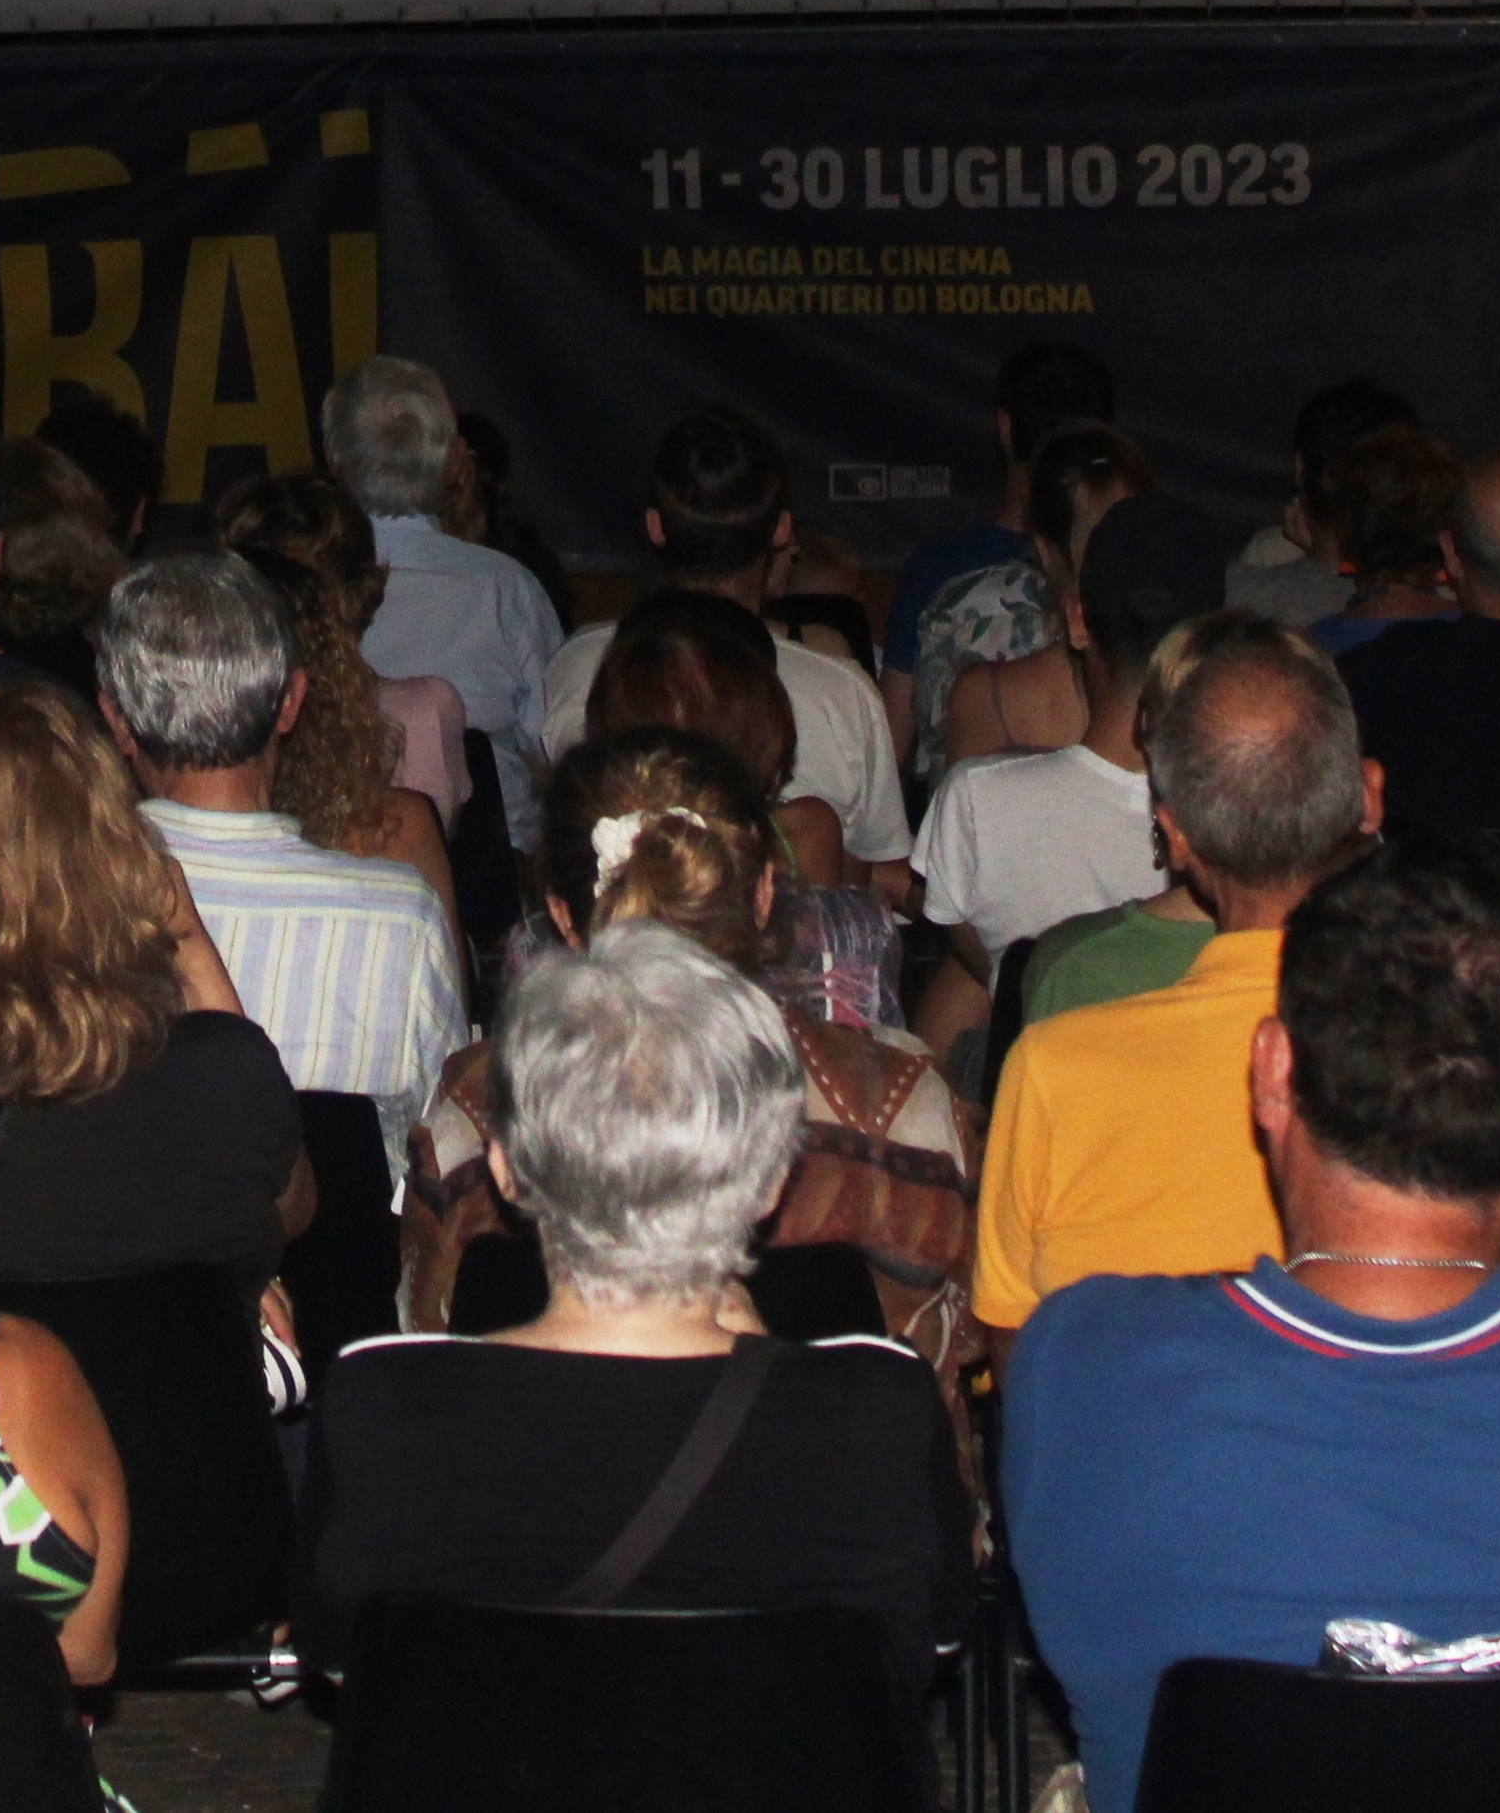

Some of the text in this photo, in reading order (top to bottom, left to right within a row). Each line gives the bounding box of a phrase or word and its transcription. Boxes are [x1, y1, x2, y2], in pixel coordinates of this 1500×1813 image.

[641, 147, 701, 211] 11
[758, 147, 845, 211] 30
[864, 145, 1118, 210] LUGLIO
[1135, 142, 1312, 208] 2023
[641, 245, 1012, 278] LA MAGIA DEL CINEMA
[644, 283, 1095, 319] NEI QUARTIERI DI BOLOGNA
